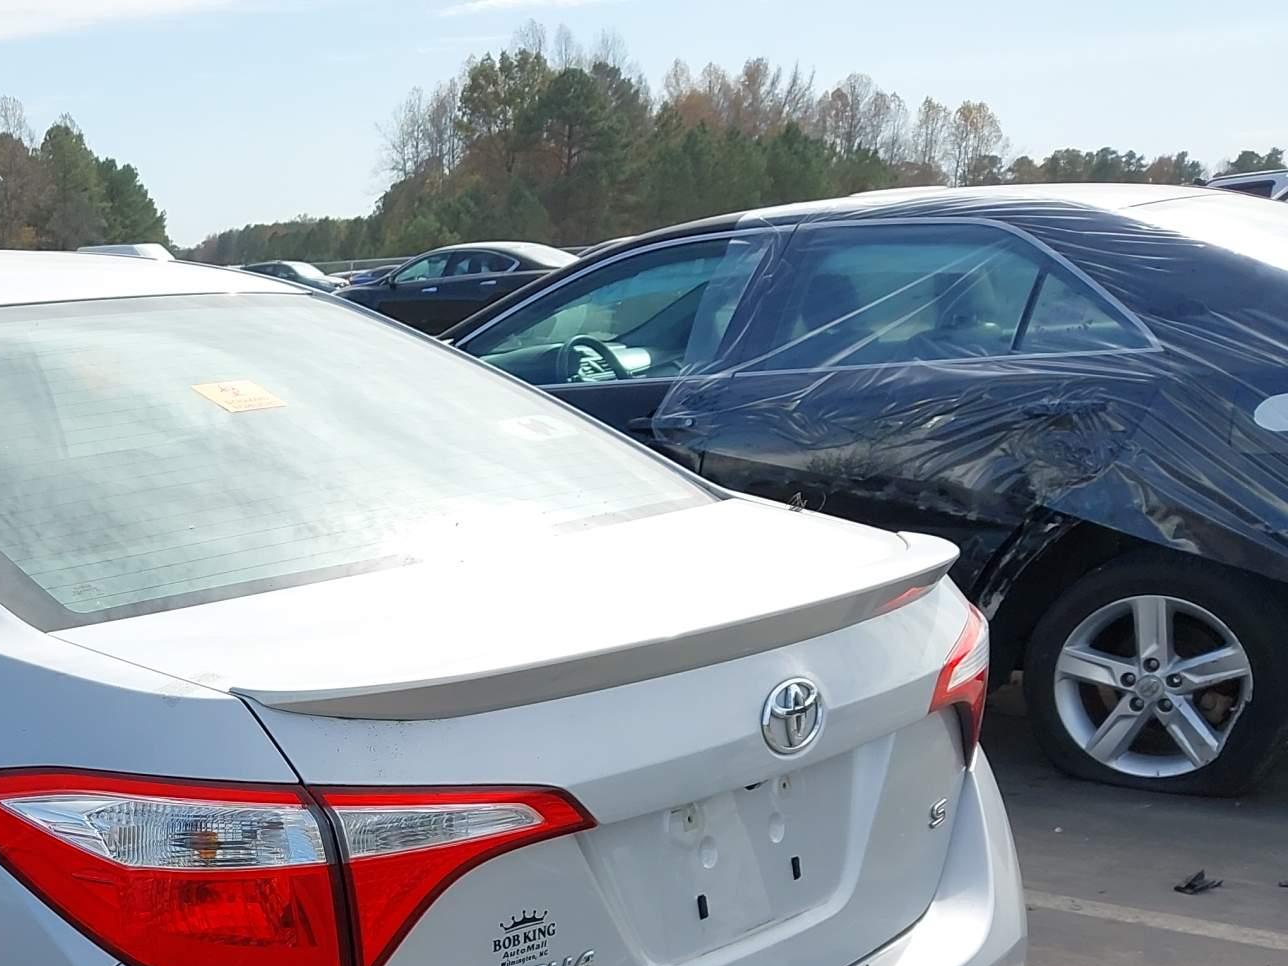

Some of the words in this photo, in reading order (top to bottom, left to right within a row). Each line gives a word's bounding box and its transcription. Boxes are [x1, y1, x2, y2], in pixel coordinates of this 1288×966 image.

[492, 934, 521, 952] BOB
[523, 922, 557, 944] KING
[502, 940, 547, 960] AutoMall
